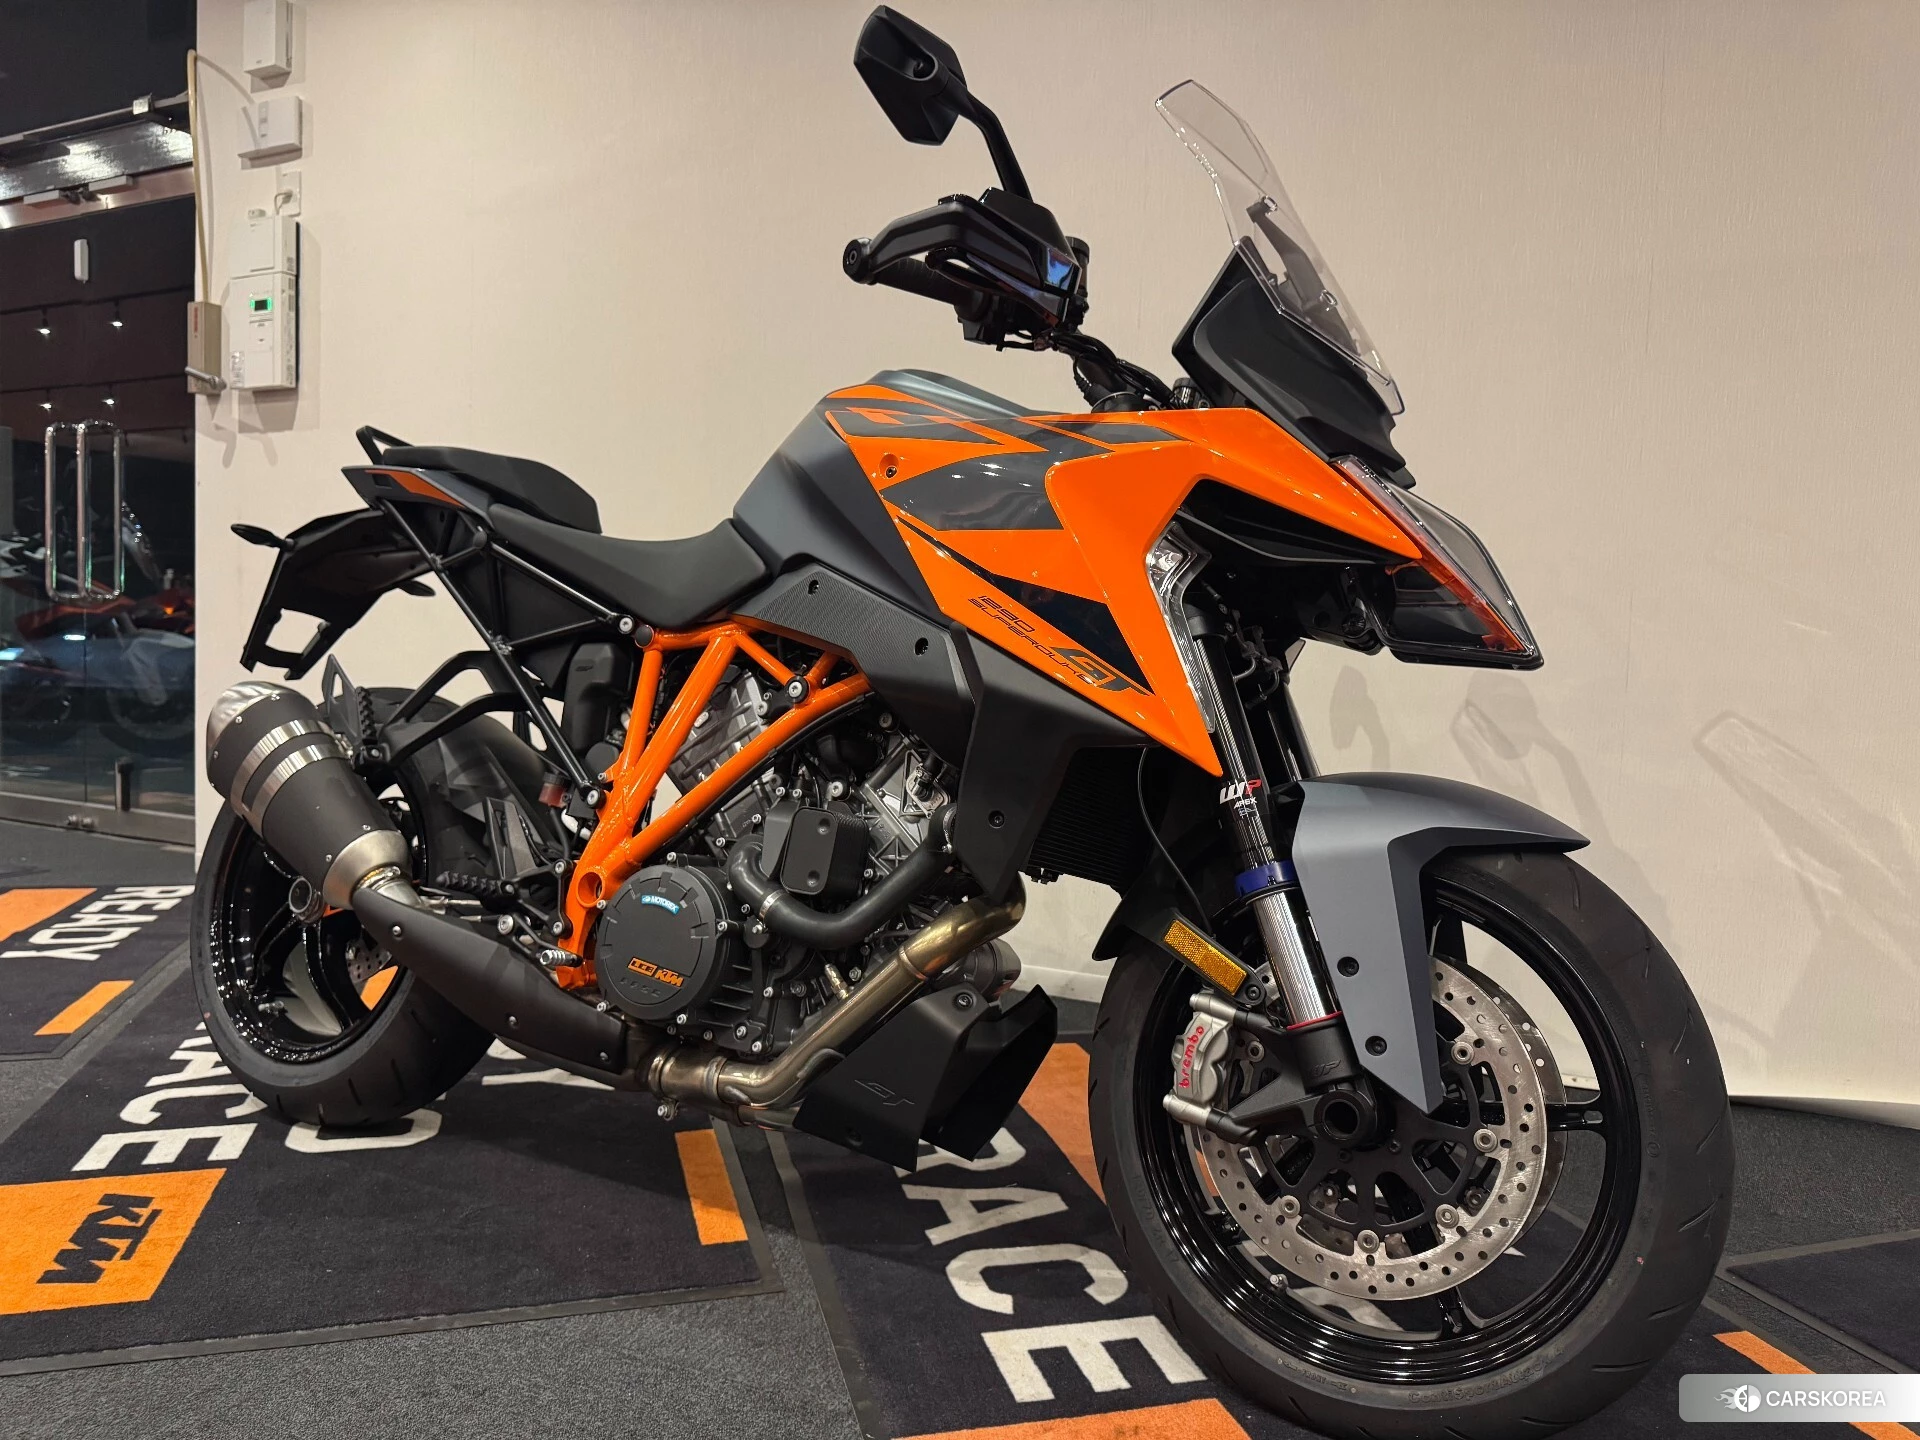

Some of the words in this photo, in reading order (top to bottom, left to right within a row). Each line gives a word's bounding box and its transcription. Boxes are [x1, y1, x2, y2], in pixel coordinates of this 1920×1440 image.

[978, 596, 1035, 632] 1290
[1220, 779, 1262, 804] WP
[0, 885, 196, 961] READY
[651, 895, 678, 912] MOTOREX
[655, 968, 684, 987] KTM
[1178, 1026, 1204, 1088] brembo
[71, 1021, 269, 1171] ACE
[36, 1194, 163, 1284] KTM
